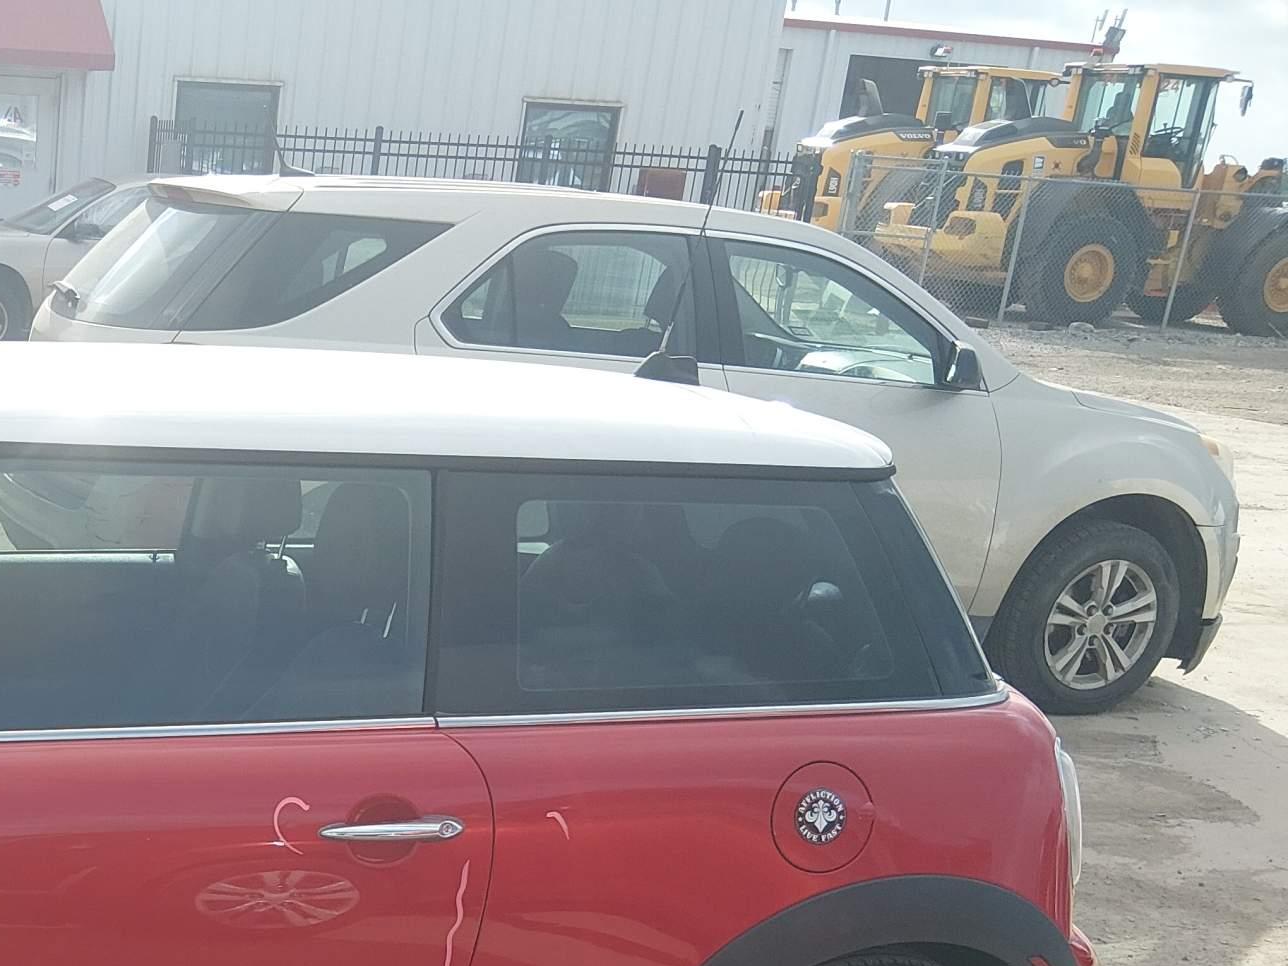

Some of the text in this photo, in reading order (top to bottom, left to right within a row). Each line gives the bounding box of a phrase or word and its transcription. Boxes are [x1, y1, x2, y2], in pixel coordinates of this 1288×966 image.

[898, 132, 932, 141] VOLVO
[798, 790, 844, 814] AFFLICTION
[800, 823, 842, 842] LIVE FAST
